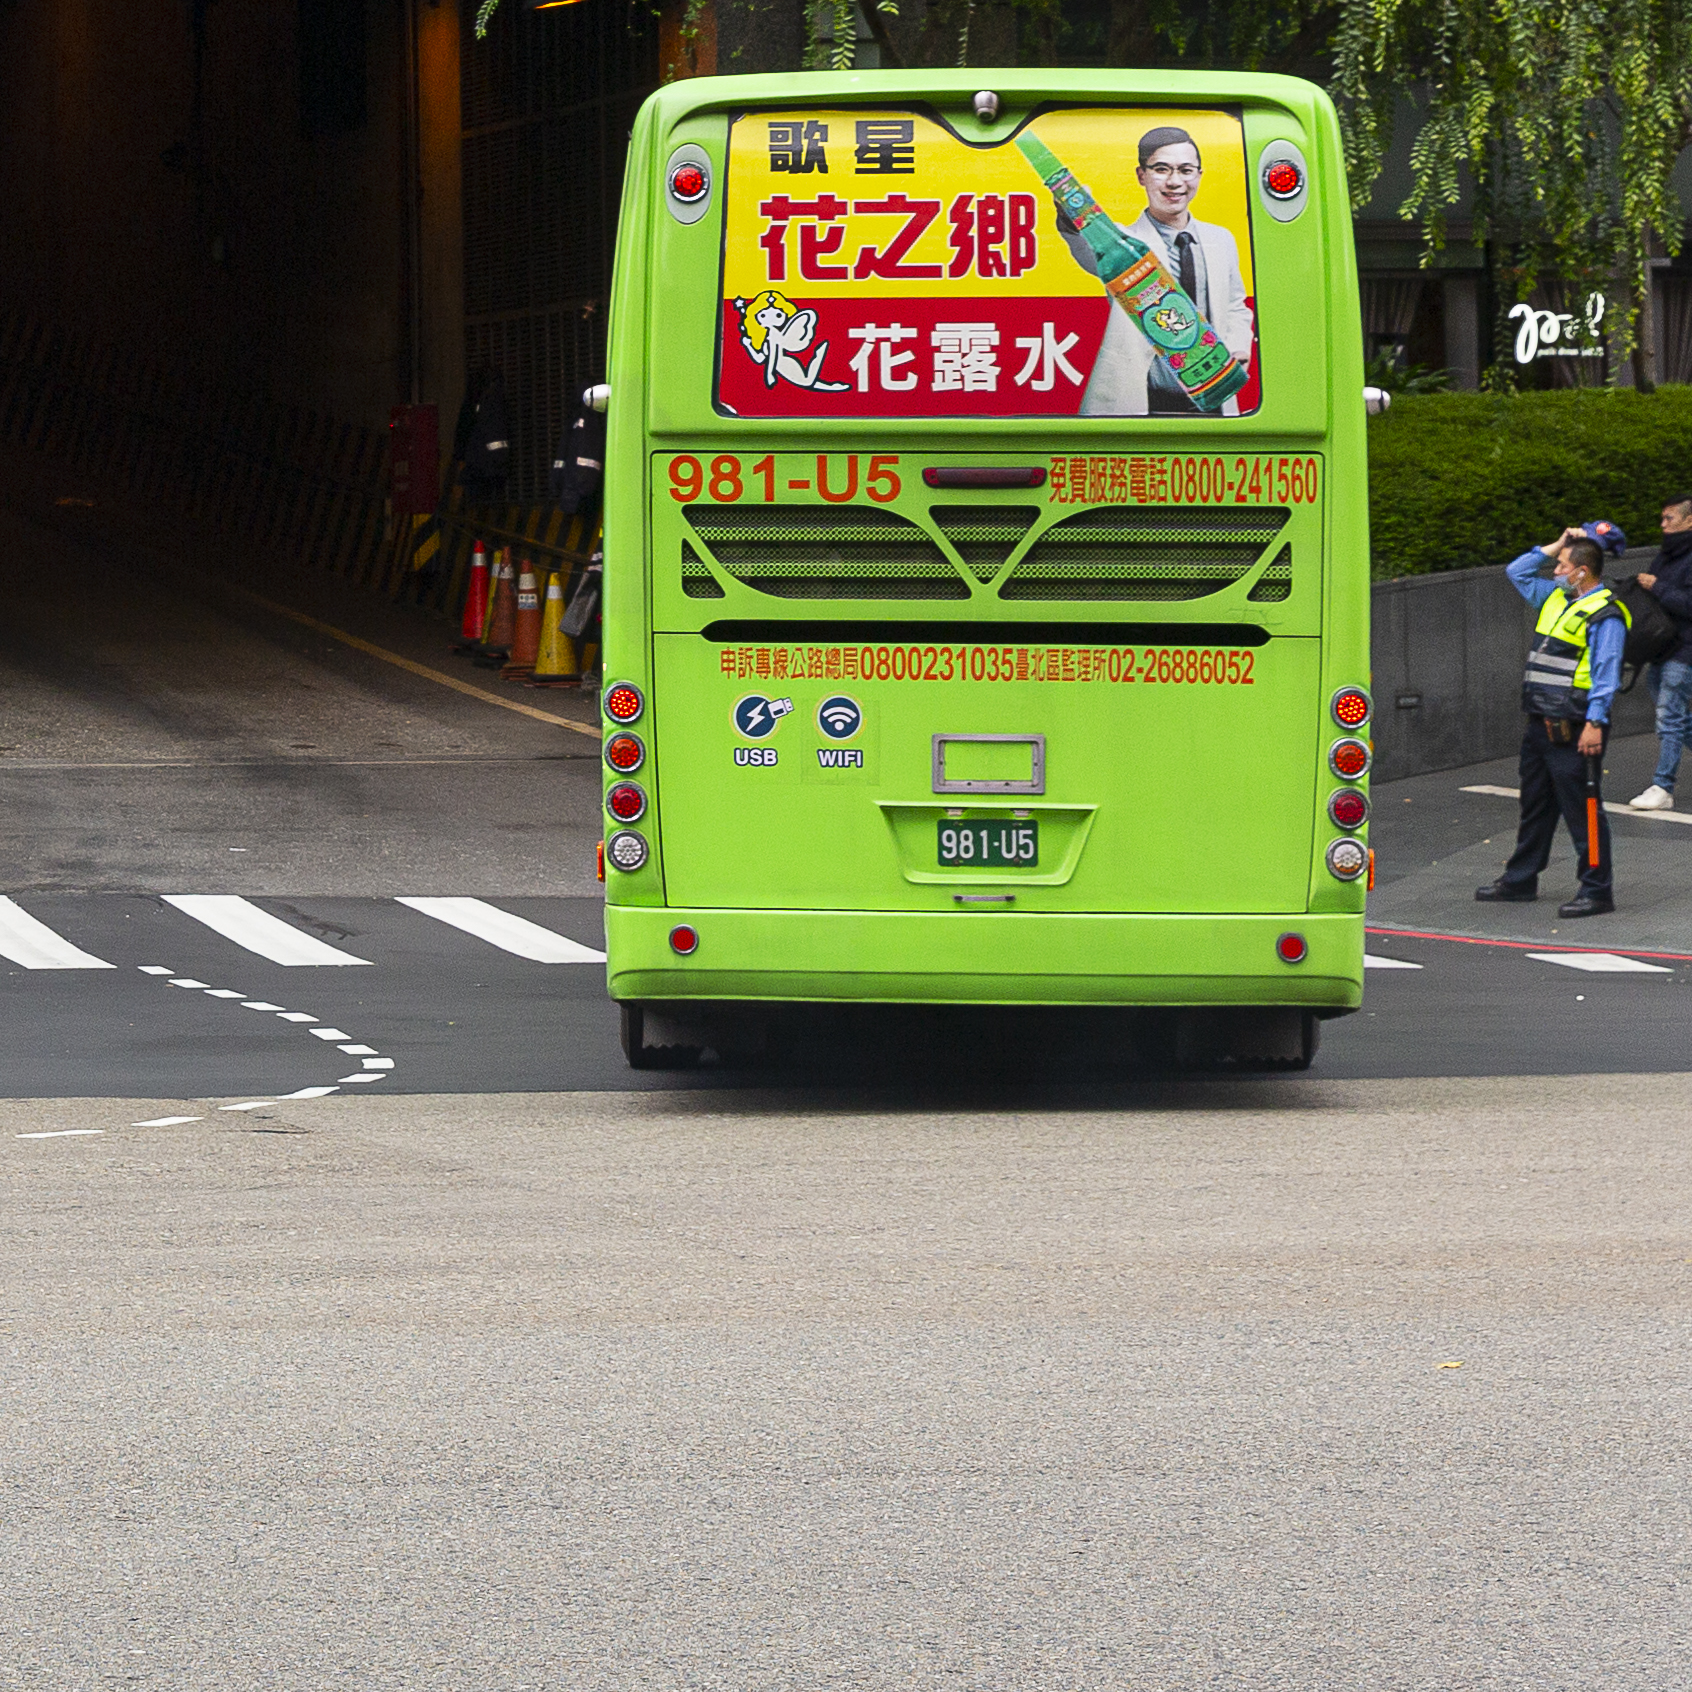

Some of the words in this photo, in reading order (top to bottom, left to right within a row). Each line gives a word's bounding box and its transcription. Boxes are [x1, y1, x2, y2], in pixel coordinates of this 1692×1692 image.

[767, 119, 915, 174] 歌星
[758, 192, 1038, 282] 花之鄉
[849, 321, 1085, 393] 花露水
[668, 454, 902, 504] 981-U5
[1048, 456, 1318, 505] 免費服務電話0800-241560
[733, 747, 778, 768] USB
[817, 748, 865, 769] WIFI
[941, 829, 1036, 861] 981-U5
